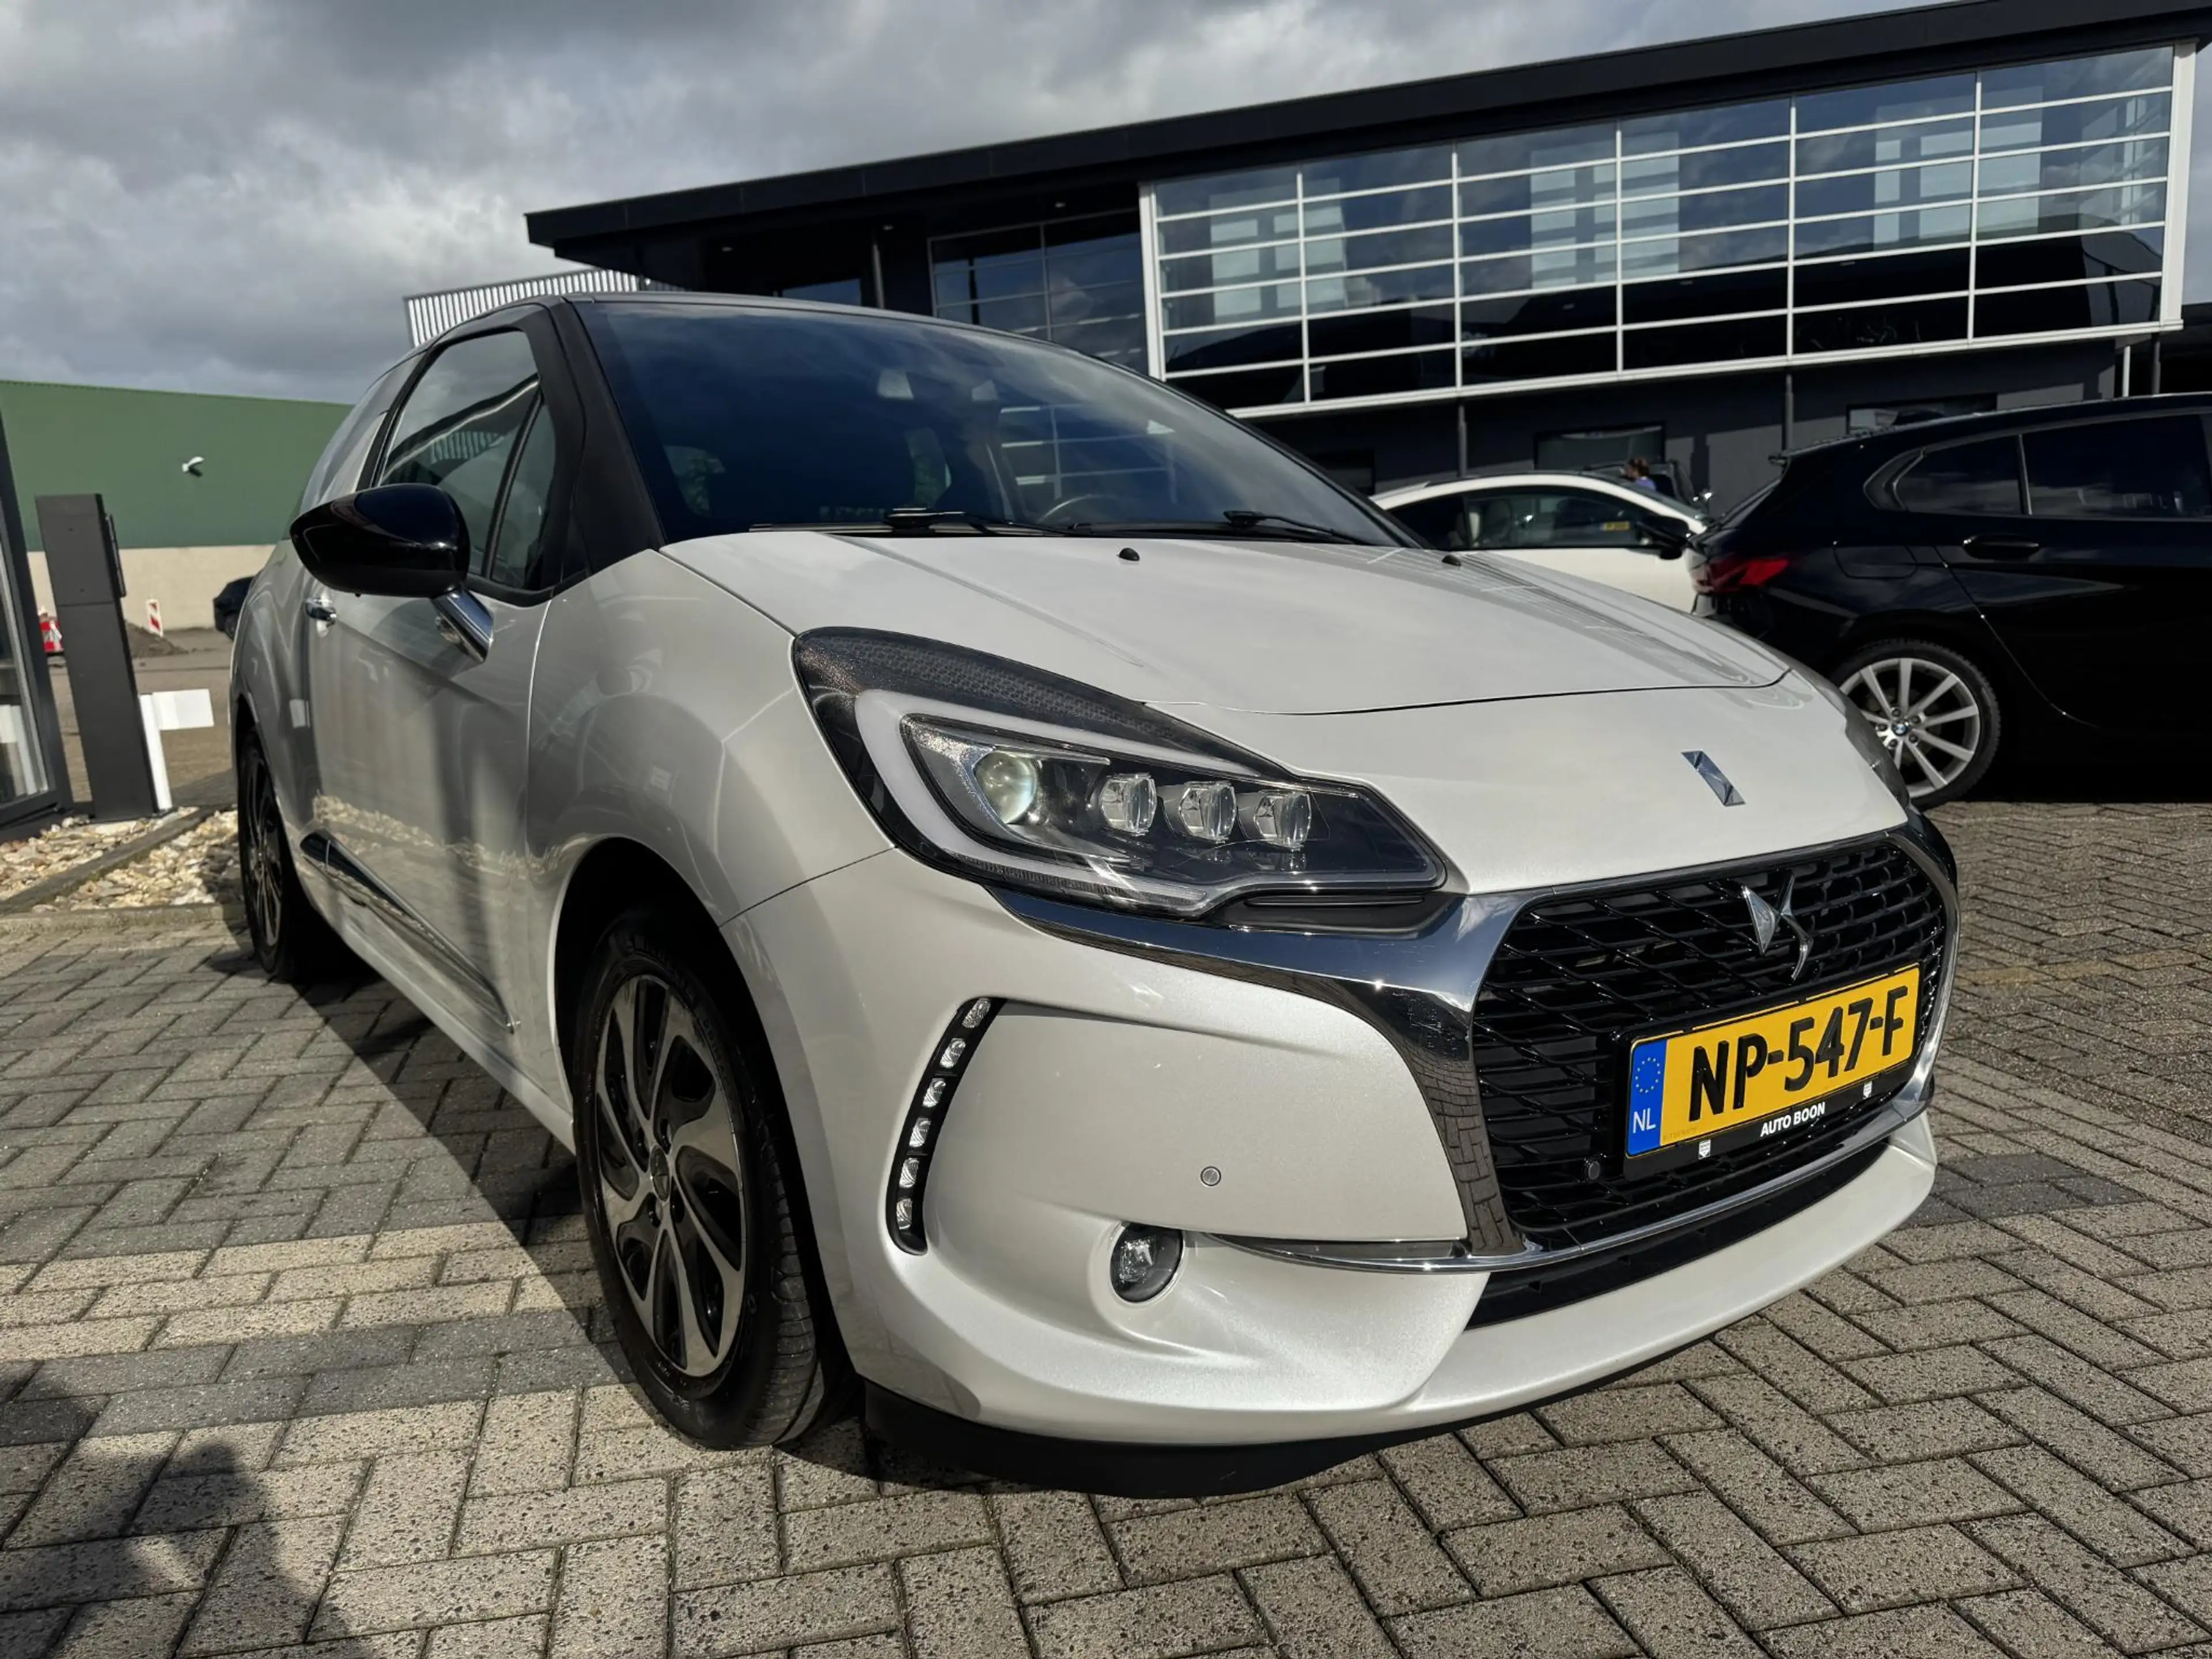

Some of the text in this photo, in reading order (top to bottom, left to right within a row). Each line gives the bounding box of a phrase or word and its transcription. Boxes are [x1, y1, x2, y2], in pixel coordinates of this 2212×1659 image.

[1688, 985, 1908, 1122] NP-547-F
[1633, 1108, 1656, 1134] NL
[1760, 1101, 1825, 1137] AUTO BOON
